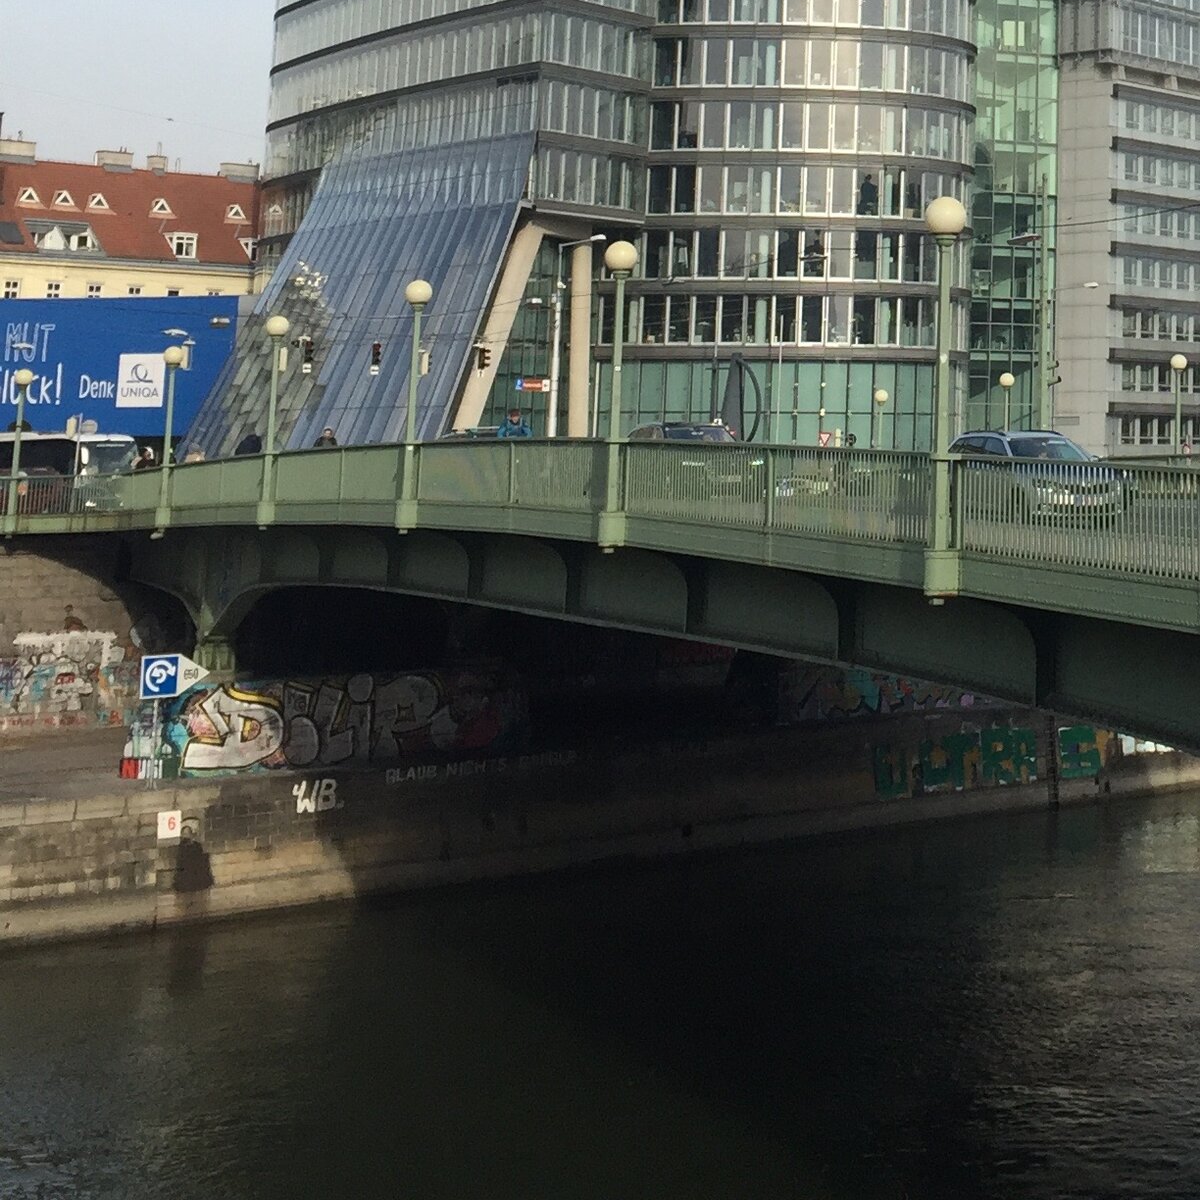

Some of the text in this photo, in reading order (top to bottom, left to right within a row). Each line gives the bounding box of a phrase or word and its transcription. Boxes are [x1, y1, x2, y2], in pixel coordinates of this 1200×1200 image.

[4, 322, 55, 362] MUT
[79, 373, 114, 399] Denk
[120, 387, 159, 398] UNIQA
[167, 816, 176, 831] 6
